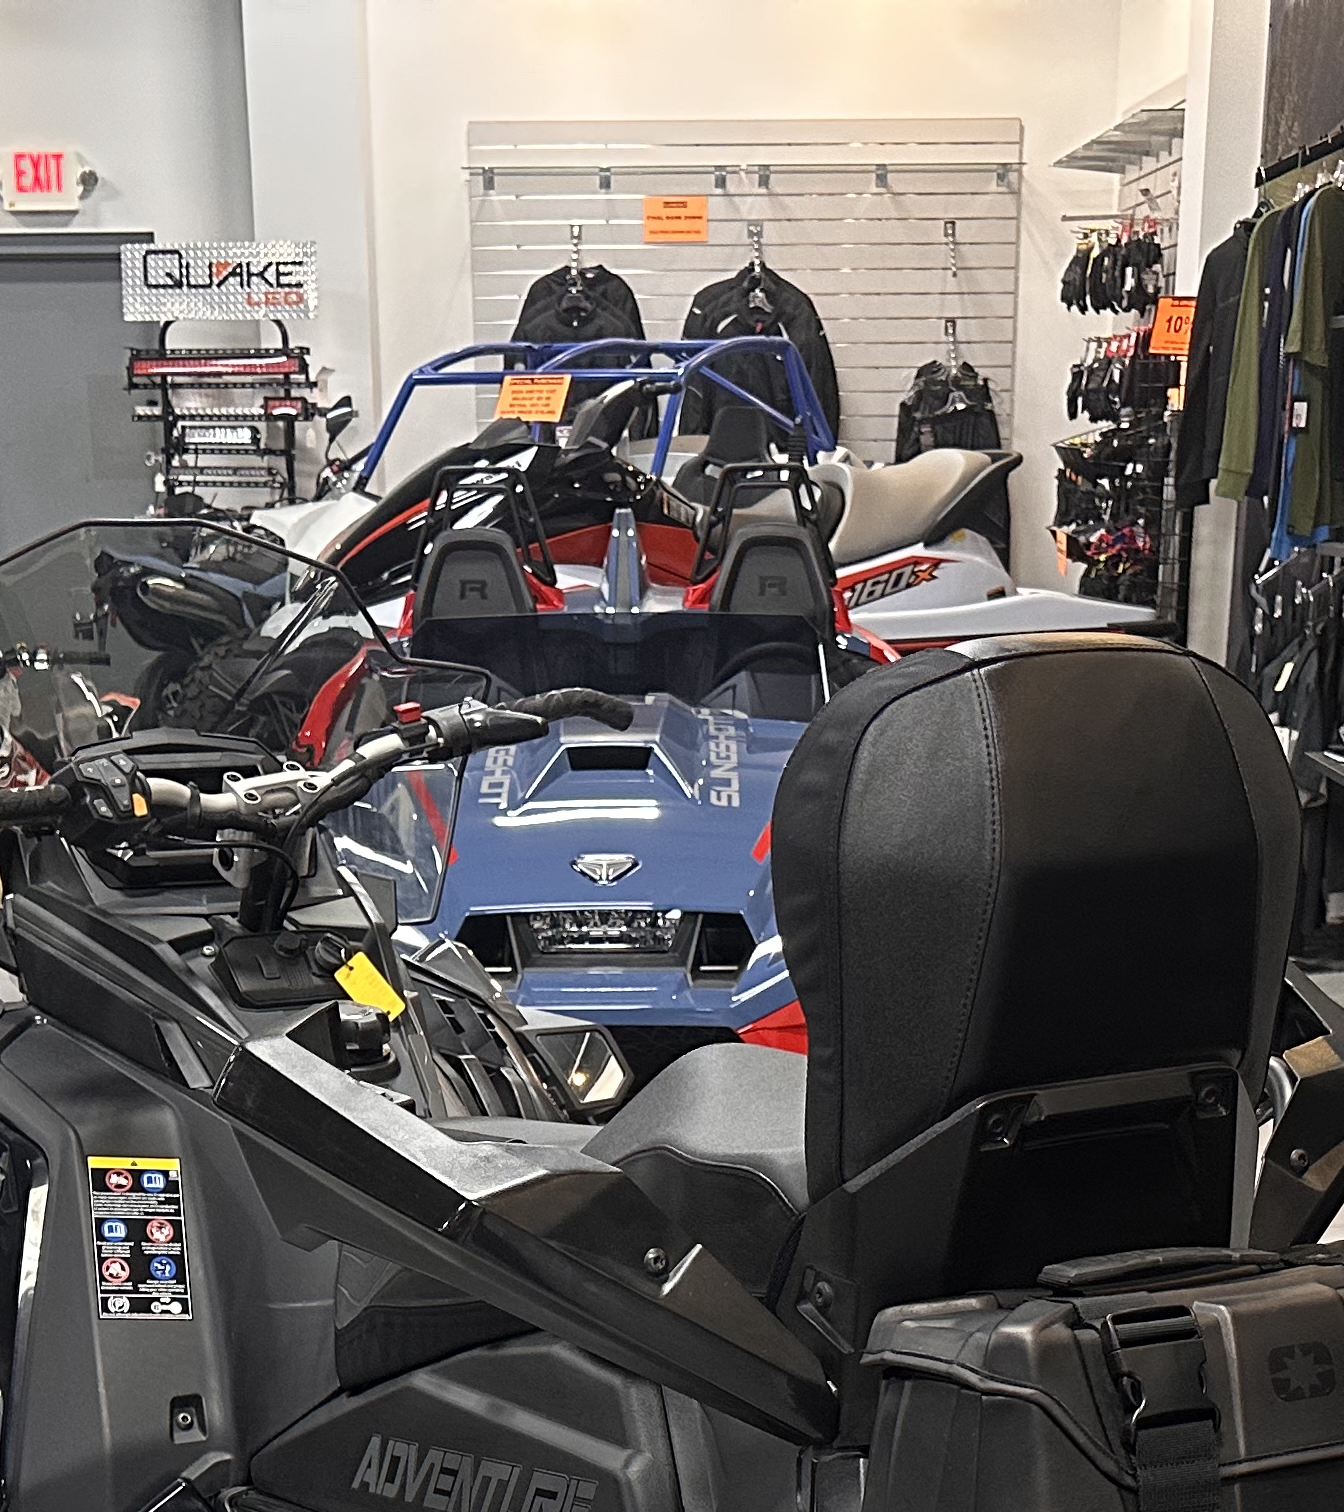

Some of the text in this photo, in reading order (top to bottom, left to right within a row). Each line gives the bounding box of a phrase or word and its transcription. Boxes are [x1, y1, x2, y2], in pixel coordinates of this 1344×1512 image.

[14, 153, 63, 193] EXIT
[143, 249, 304, 289] QUAKE
[246, 290, 305, 307] LED
[709, 716, 740, 808] SLINGSHOT
